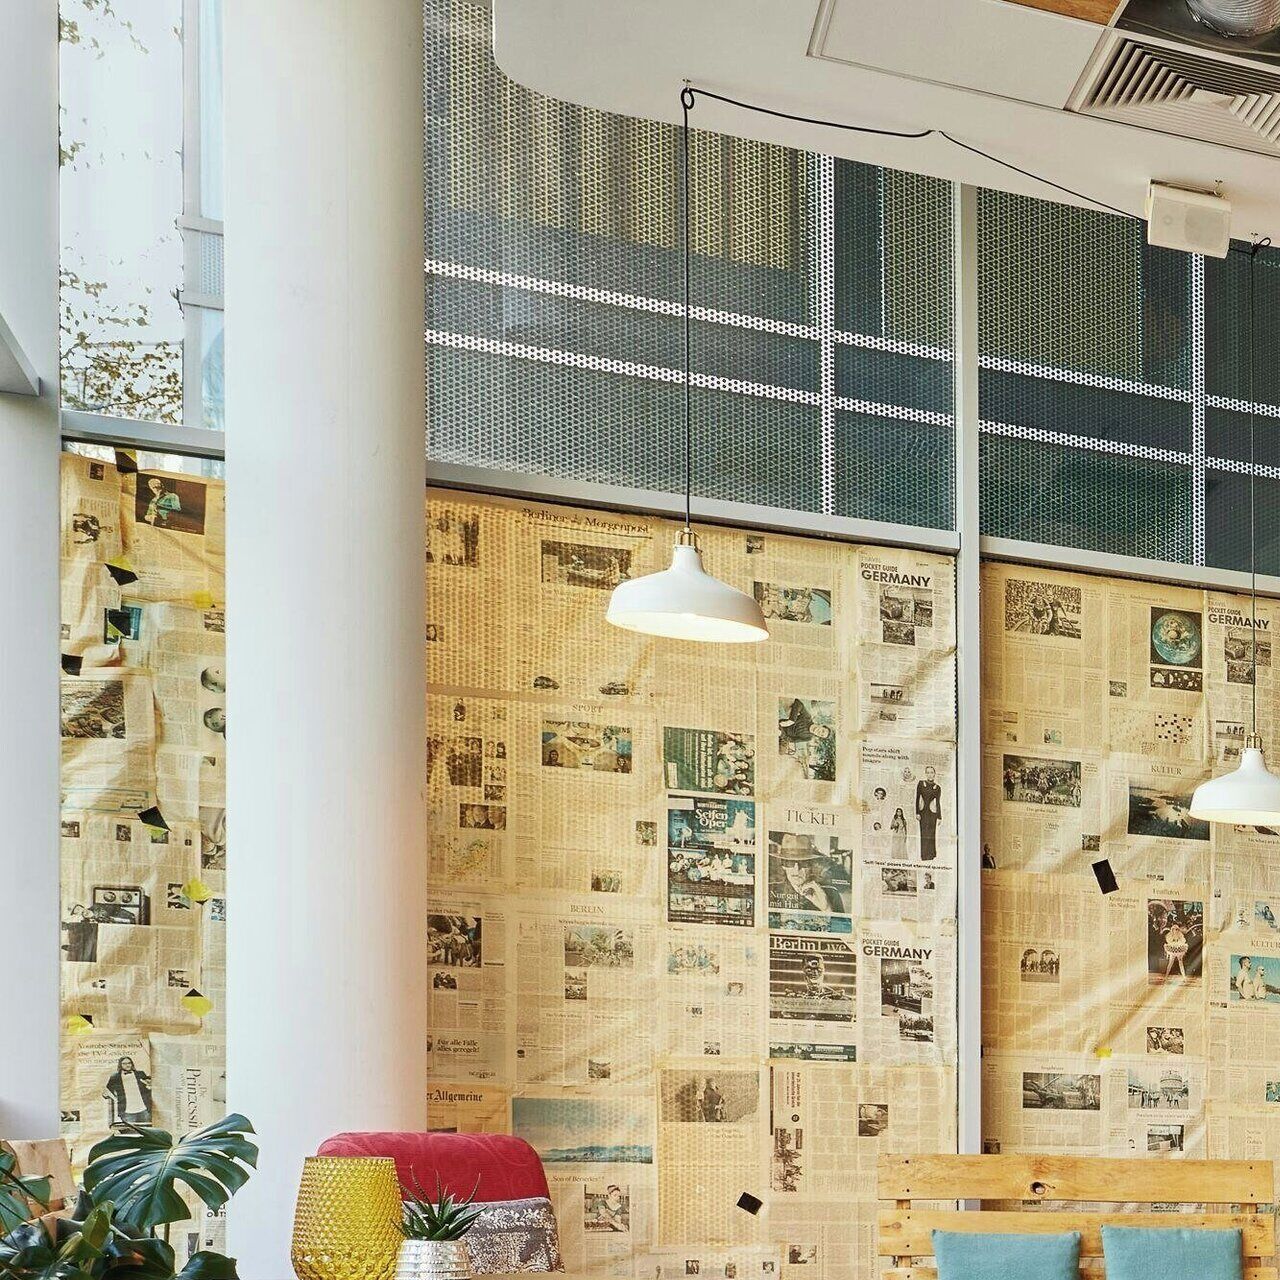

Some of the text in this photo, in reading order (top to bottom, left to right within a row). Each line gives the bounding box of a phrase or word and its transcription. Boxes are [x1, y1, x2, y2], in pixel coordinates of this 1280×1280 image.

[522, 507, 650, 534] Berliner Morgenpost
[860, 562, 898, 573] POCKET GUIDE
[861, 569, 931, 587] GERMANY
[1208, 613, 1270, 630] GERMANY
[695, 809, 728, 821] Seifen
[785, 809, 839, 826] TICKET
[699, 817, 727, 829] Oper
[772, 937, 816, 951] Berlin
[862, 938, 900, 947] POCKET GUIDE
[863, 945, 933, 960] GERMANY
[186, 1068, 203, 1129] Prinzessi
[434, 1089, 483, 1103] Allgemeine
